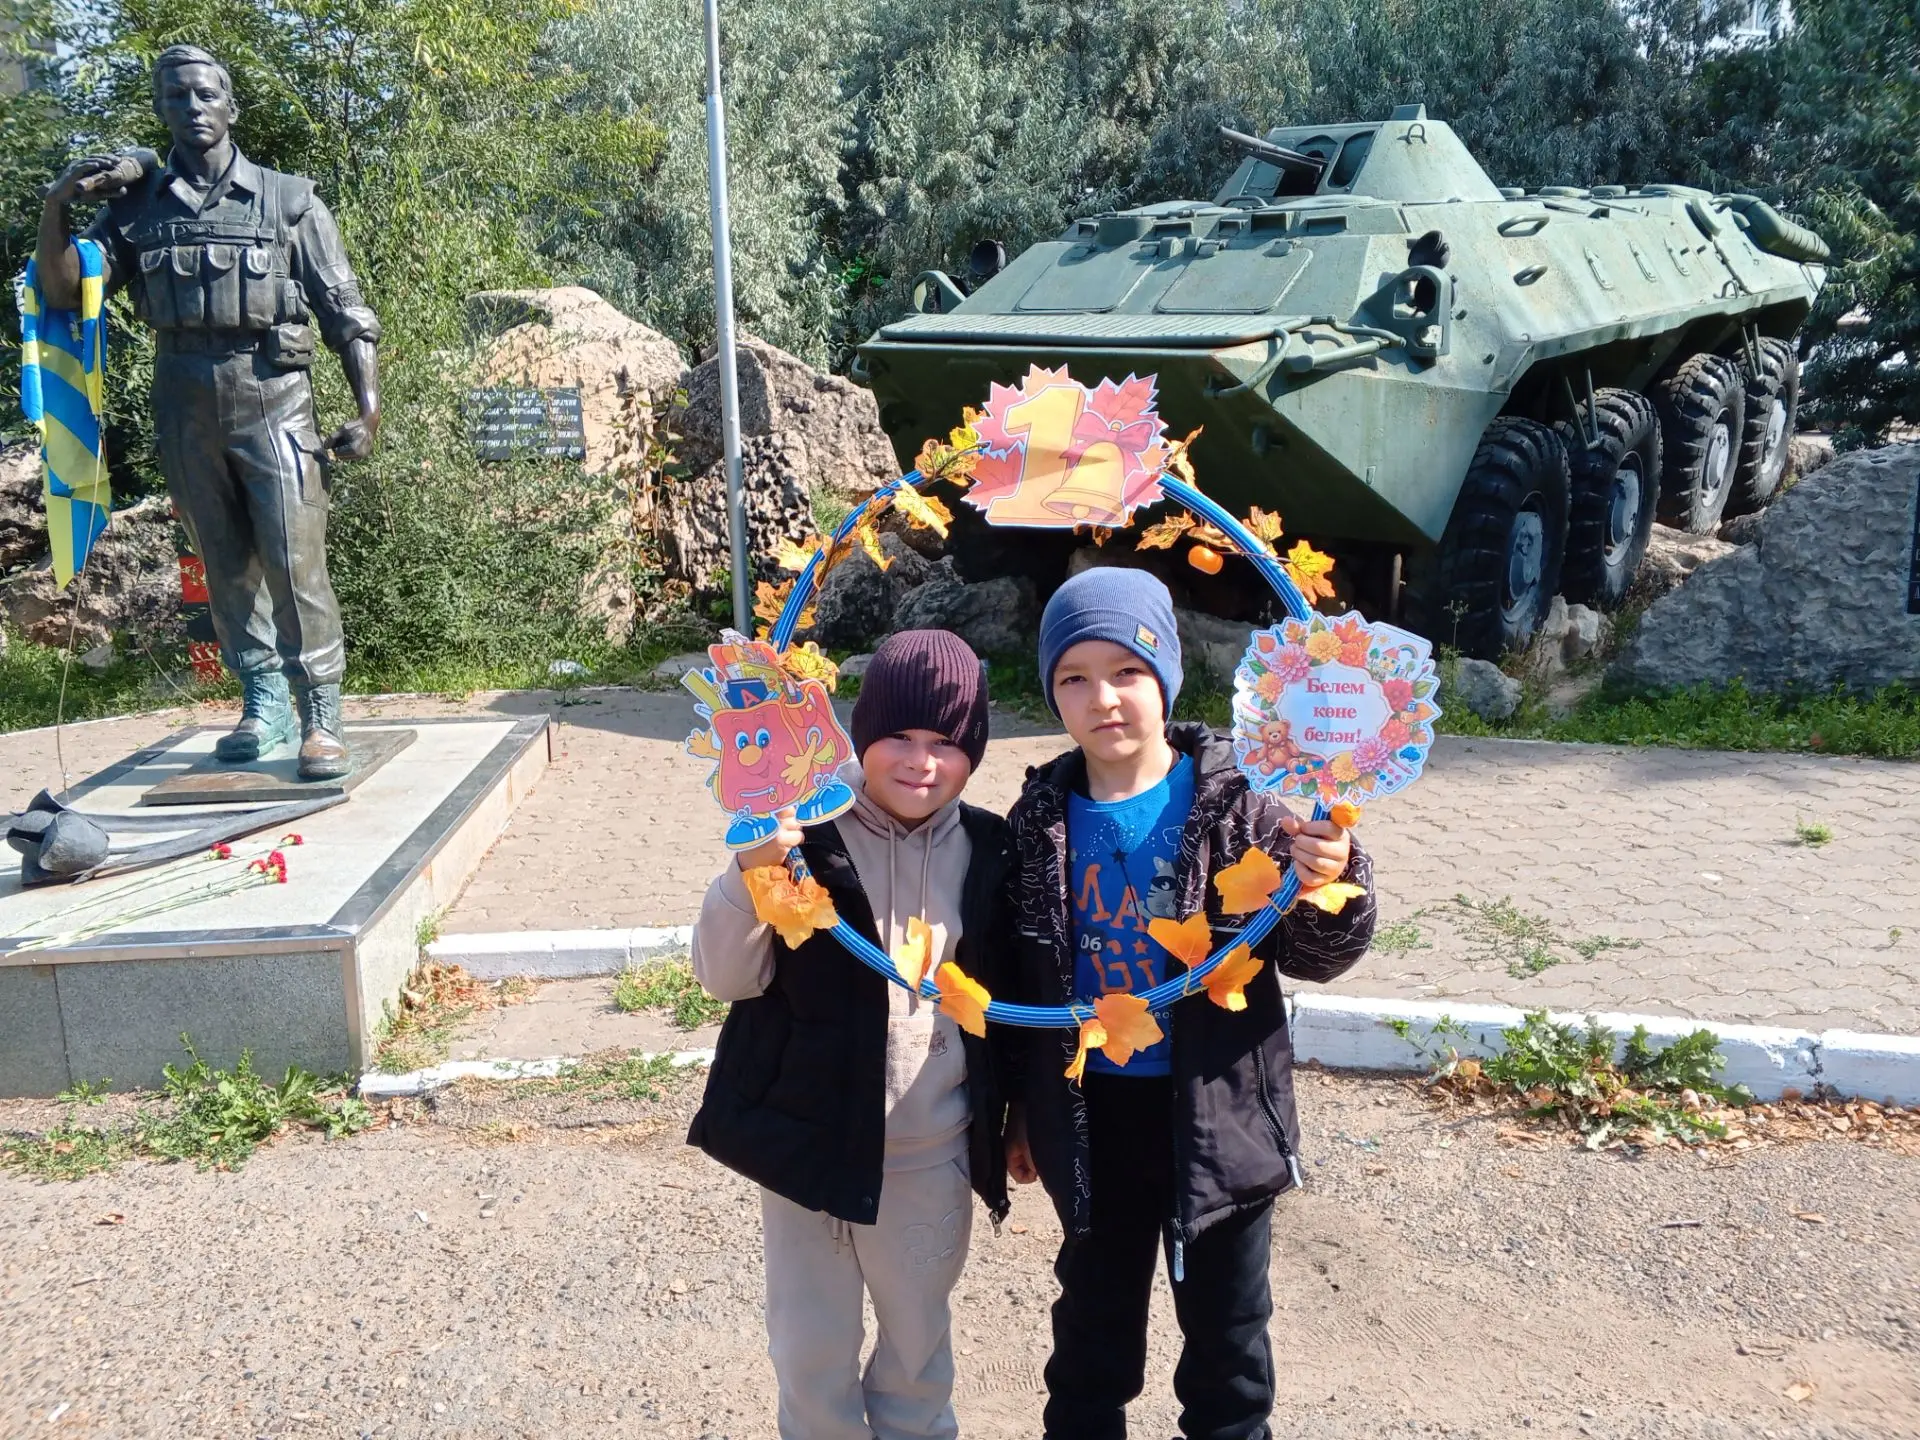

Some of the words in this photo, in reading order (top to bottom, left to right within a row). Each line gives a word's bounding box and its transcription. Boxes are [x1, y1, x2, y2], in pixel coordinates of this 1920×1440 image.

[1305, 677, 1365, 695] Белем
[1313, 705, 1357, 719] көне
[1304, 728, 1362, 744] белән!
